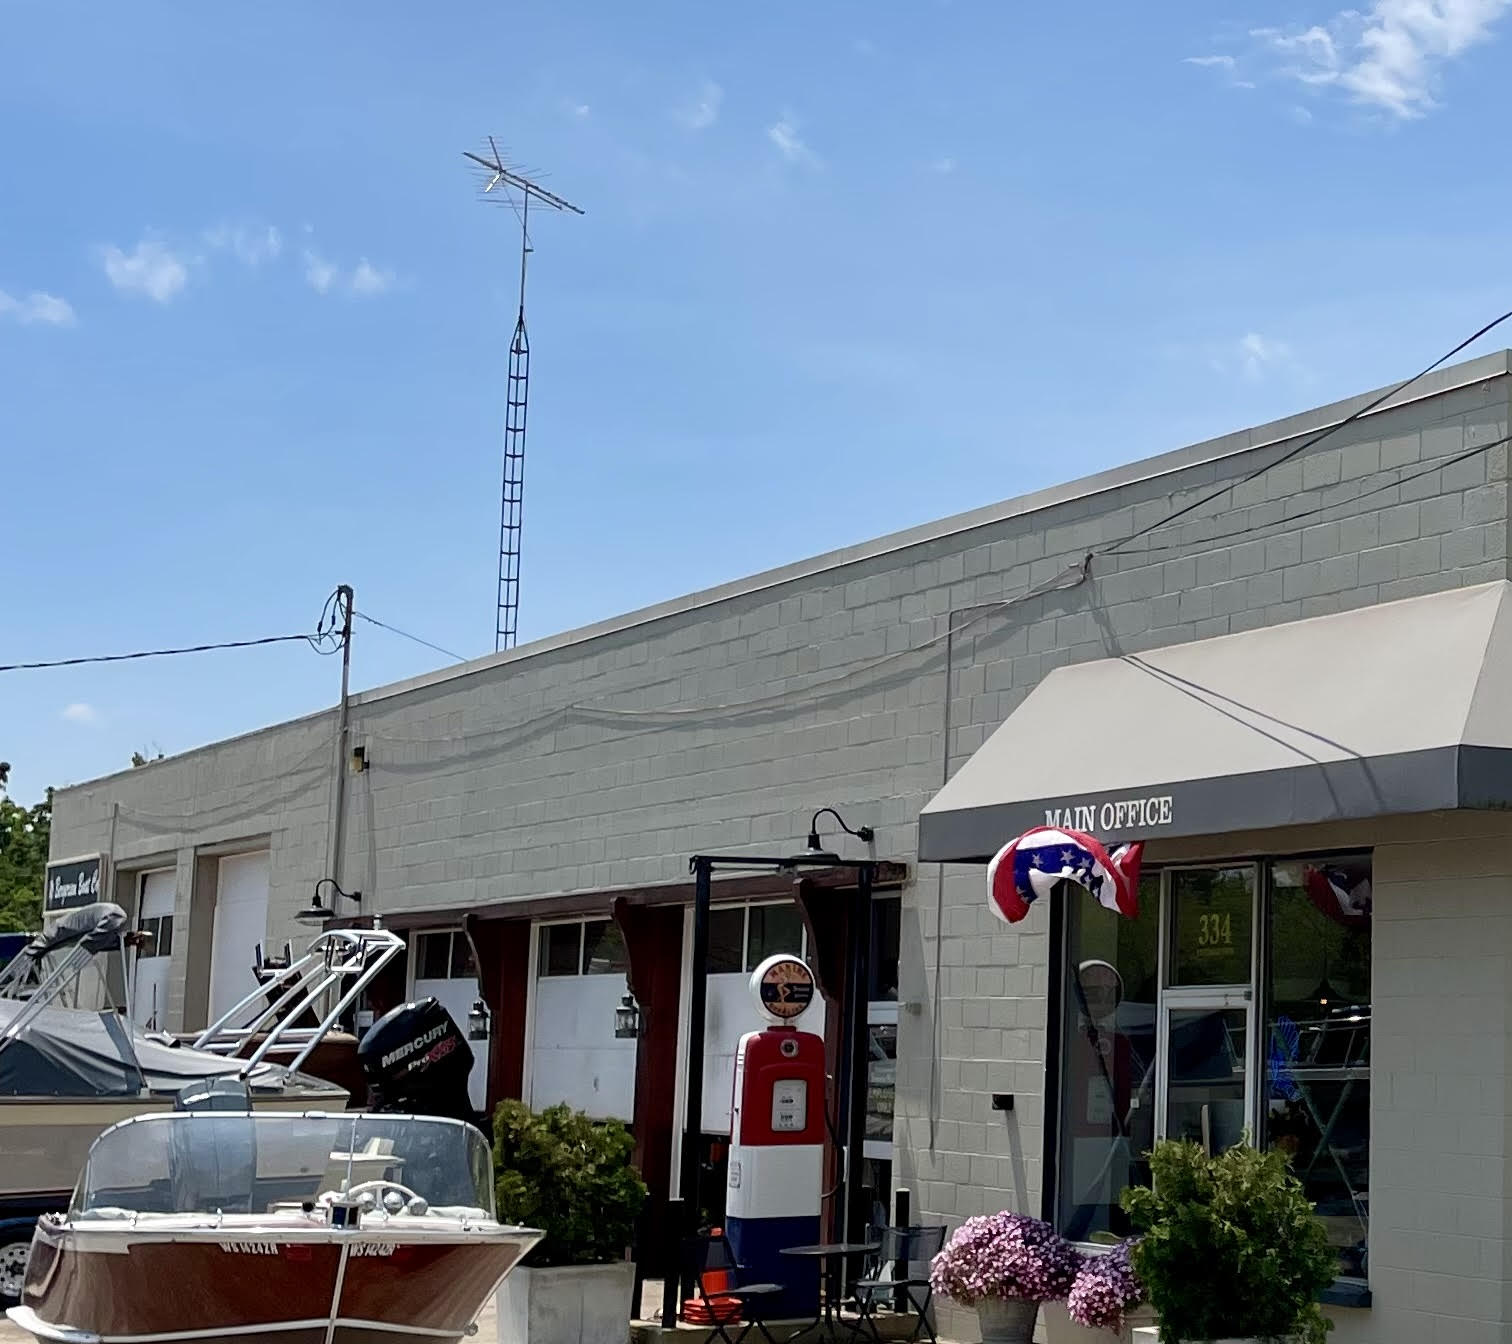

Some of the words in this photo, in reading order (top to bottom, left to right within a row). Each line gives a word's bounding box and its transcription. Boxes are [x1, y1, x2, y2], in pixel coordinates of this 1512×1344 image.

[1045, 805, 1097, 833] MAIN
[1100, 796, 1173, 831] OFFICE
[1198, 912, 1232, 945] 334
[381, 1020, 449, 1068] MERCURY
